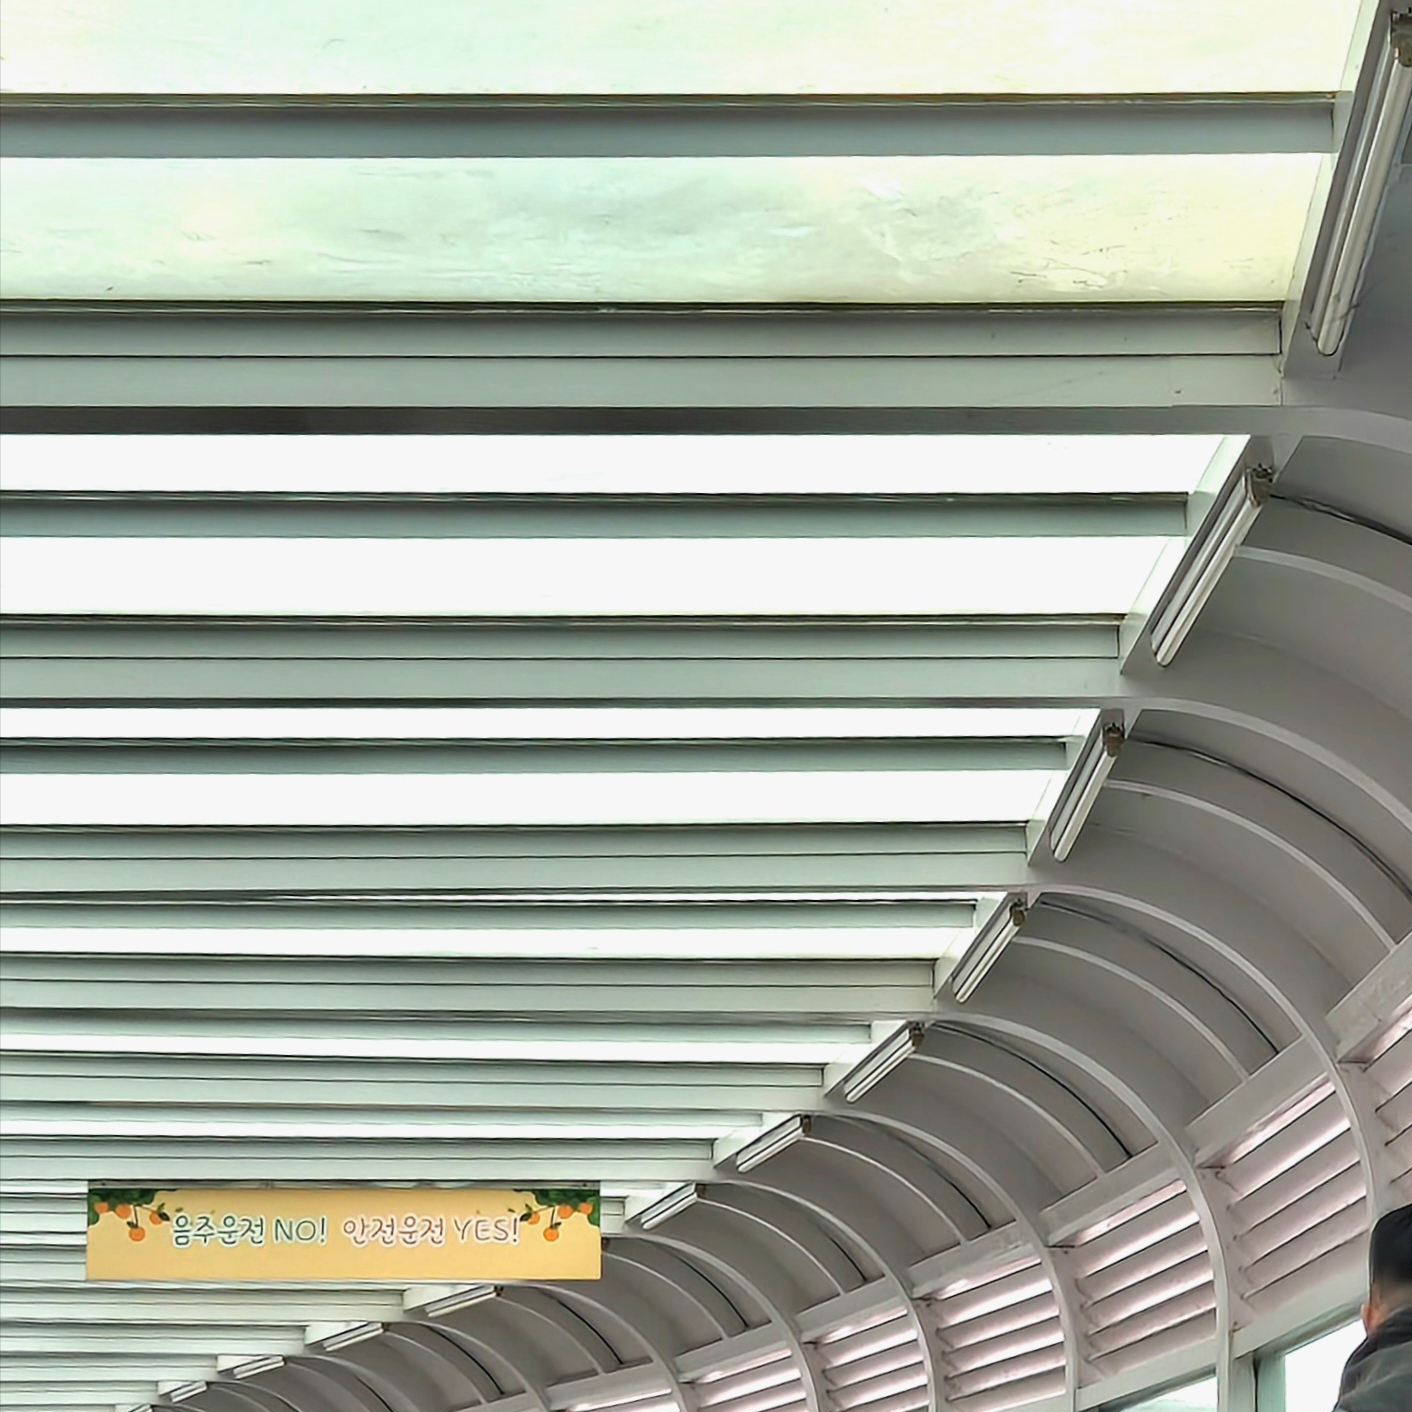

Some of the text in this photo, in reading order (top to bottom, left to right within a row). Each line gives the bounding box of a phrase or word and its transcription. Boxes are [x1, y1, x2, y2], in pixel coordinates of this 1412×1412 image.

[173, 1214, 520, 1246] 음주운전 NO! 안전운전 YES!
